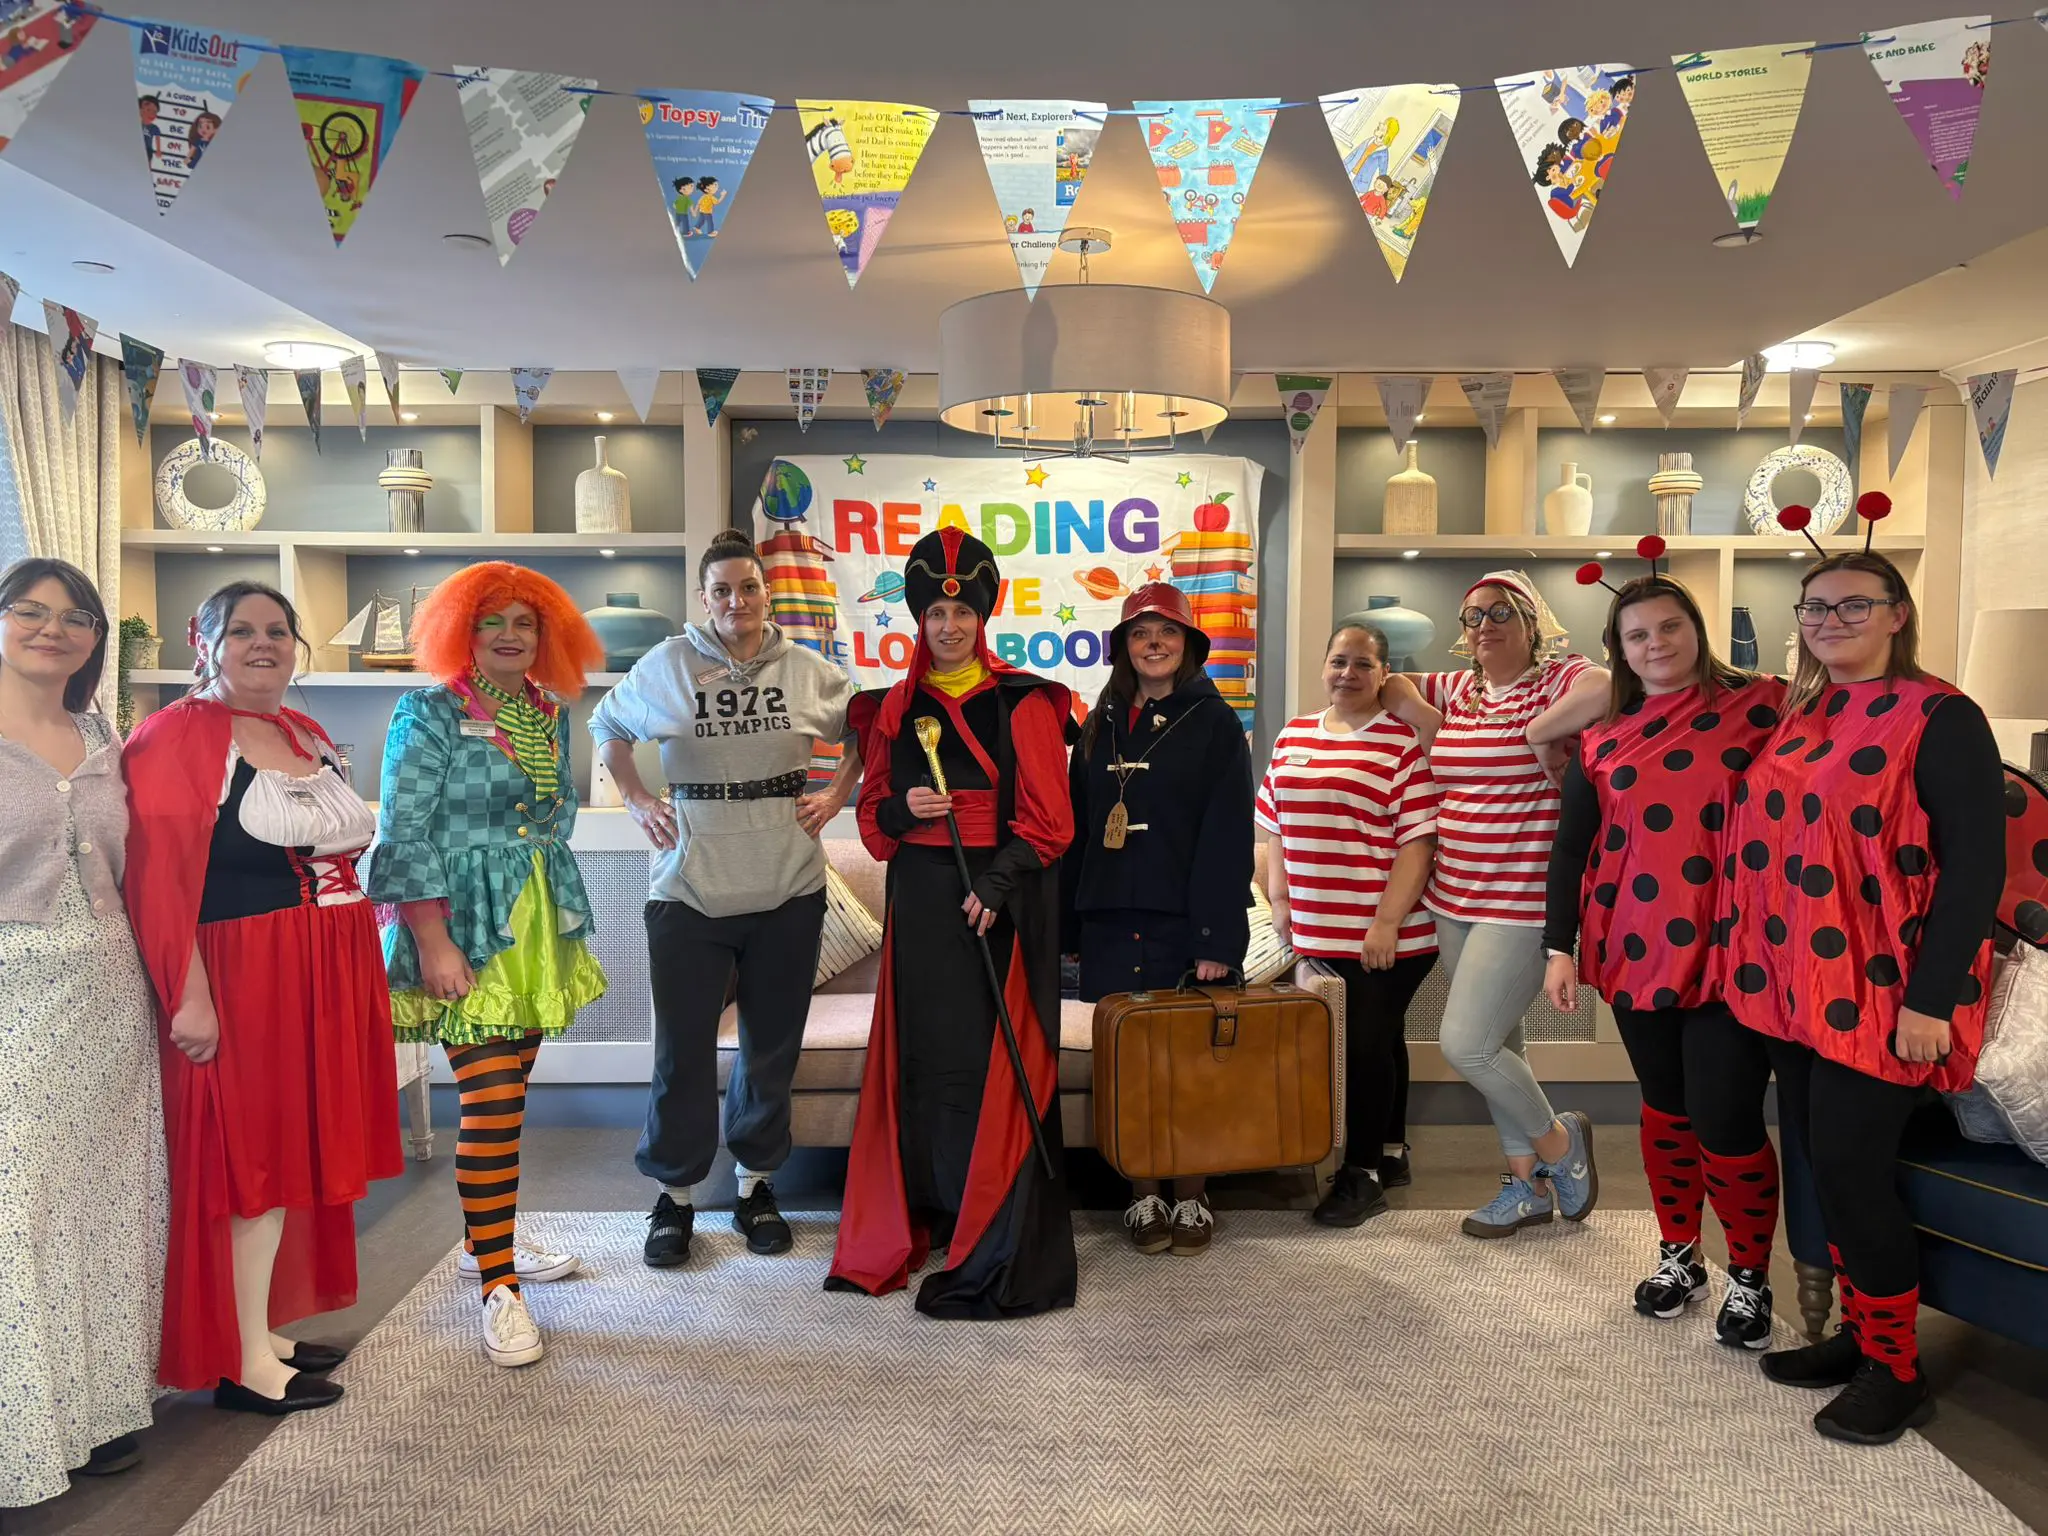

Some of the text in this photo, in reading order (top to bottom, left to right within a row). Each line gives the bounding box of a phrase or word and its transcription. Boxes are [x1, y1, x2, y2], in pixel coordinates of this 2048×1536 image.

[171, 27, 238, 61] KidsOut
[1885, 47, 1906, 58] AND
[1908, 42, 1936, 55] BAKE
[1686, 66, 1768, 84] WORLD STORIES
[173, 93, 197, 103] GUIDE
[173, 107, 187, 116] TO
[658, 102, 721, 129] Topsy
[721, 115, 737, 123] and
[974, 111, 1077, 122] Whats Next, Explorers?
[876, 112, 904, 125] O'Reilly
[169, 125, 184, 134] BE
[856, 137, 869, 145] and
[871, 137, 886, 145] Dad
[167, 142, 182, 152] ON
[711, 144, 725, 154] just
[727, 145, 741, 154] like
[861, 149, 878, 158] How
[162, 159, 182, 169] THE
[871, 160, 887, 169] have
[889, 162, 896, 170] to
[855, 169, 876, 179] before
[877, 170, 891, 181] they
[156, 178, 181, 189] SAFE
[853, 181, 880, 190] give in?
[833, 497, 1160, 556] READING
[853, 630, 1116, 669] LO BOO
[695, 686, 788, 720] 1972
[695, 715, 792, 738] OLYMPICS
